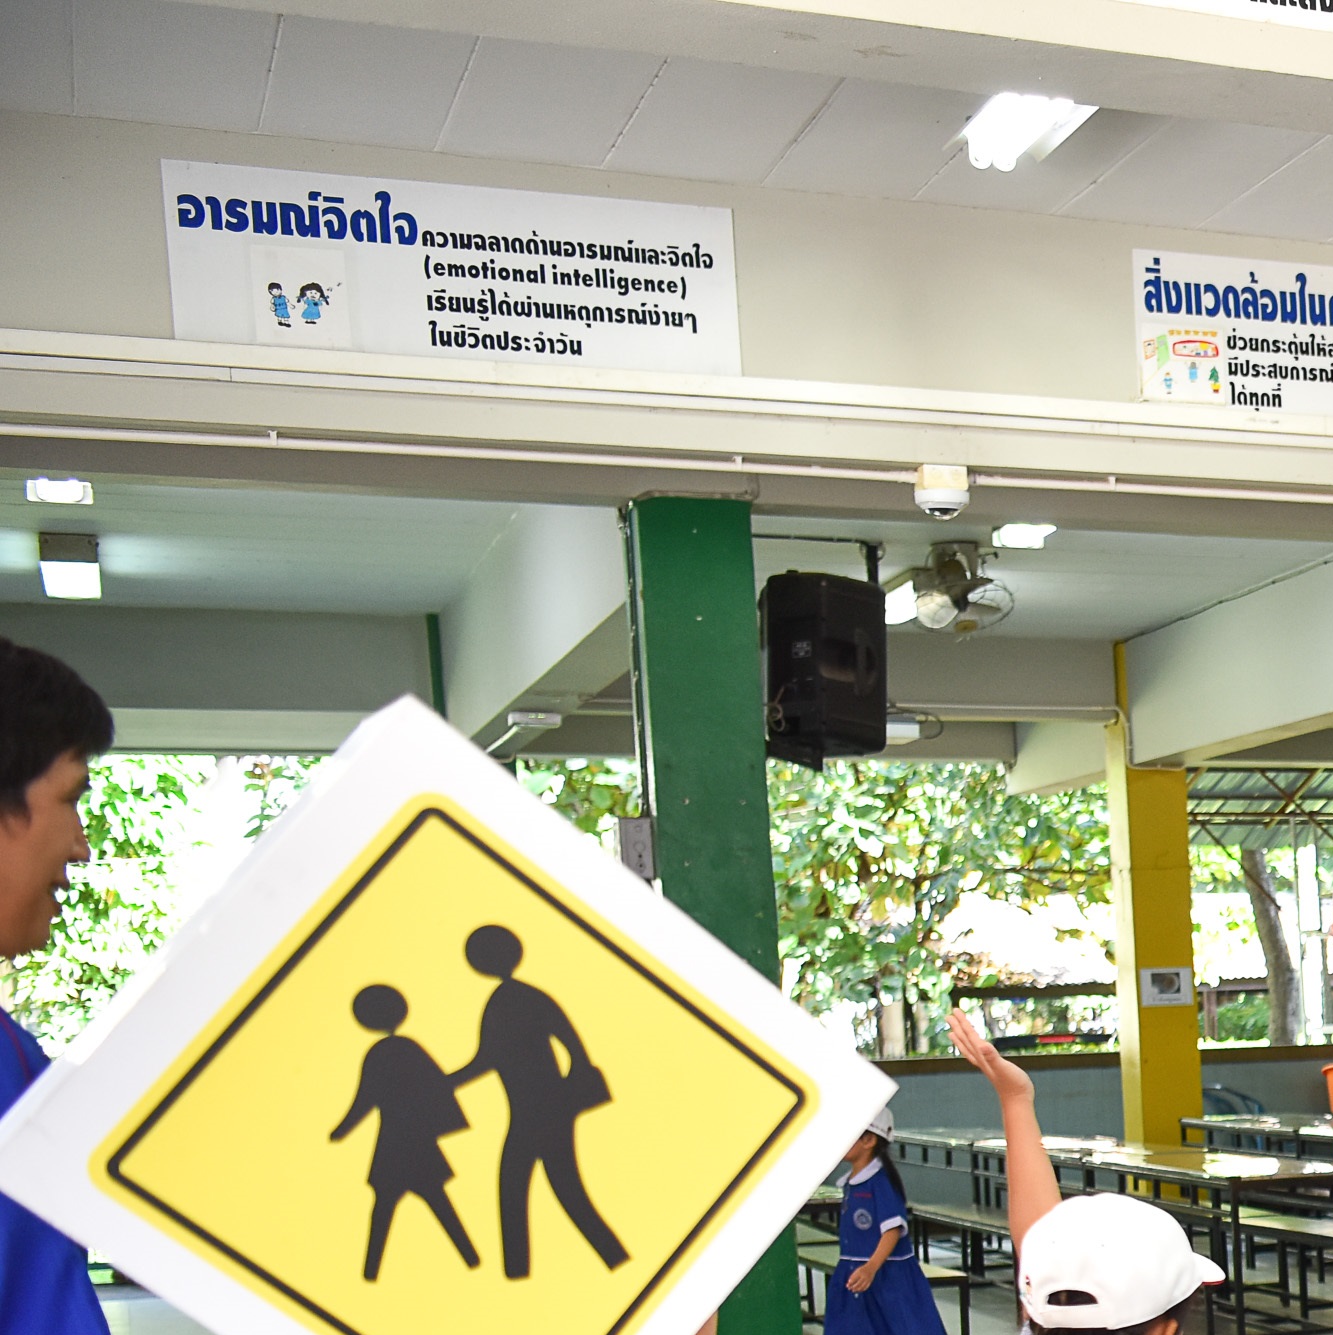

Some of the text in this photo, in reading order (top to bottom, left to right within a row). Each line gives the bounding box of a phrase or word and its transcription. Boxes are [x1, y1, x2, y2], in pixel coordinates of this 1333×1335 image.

[177, 191, 418, 246] อารมณ์จิตใจ
[421, 231, 714, 270] ความฉลาดด้านอารมณ์และจิตใจ
[423, 255, 688, 300] (emotional intelligence)
[428, 321, 583, 357] ในชีวิตประจำวัน
[1230, 381, 1282, 412] ได้ทุกที่
